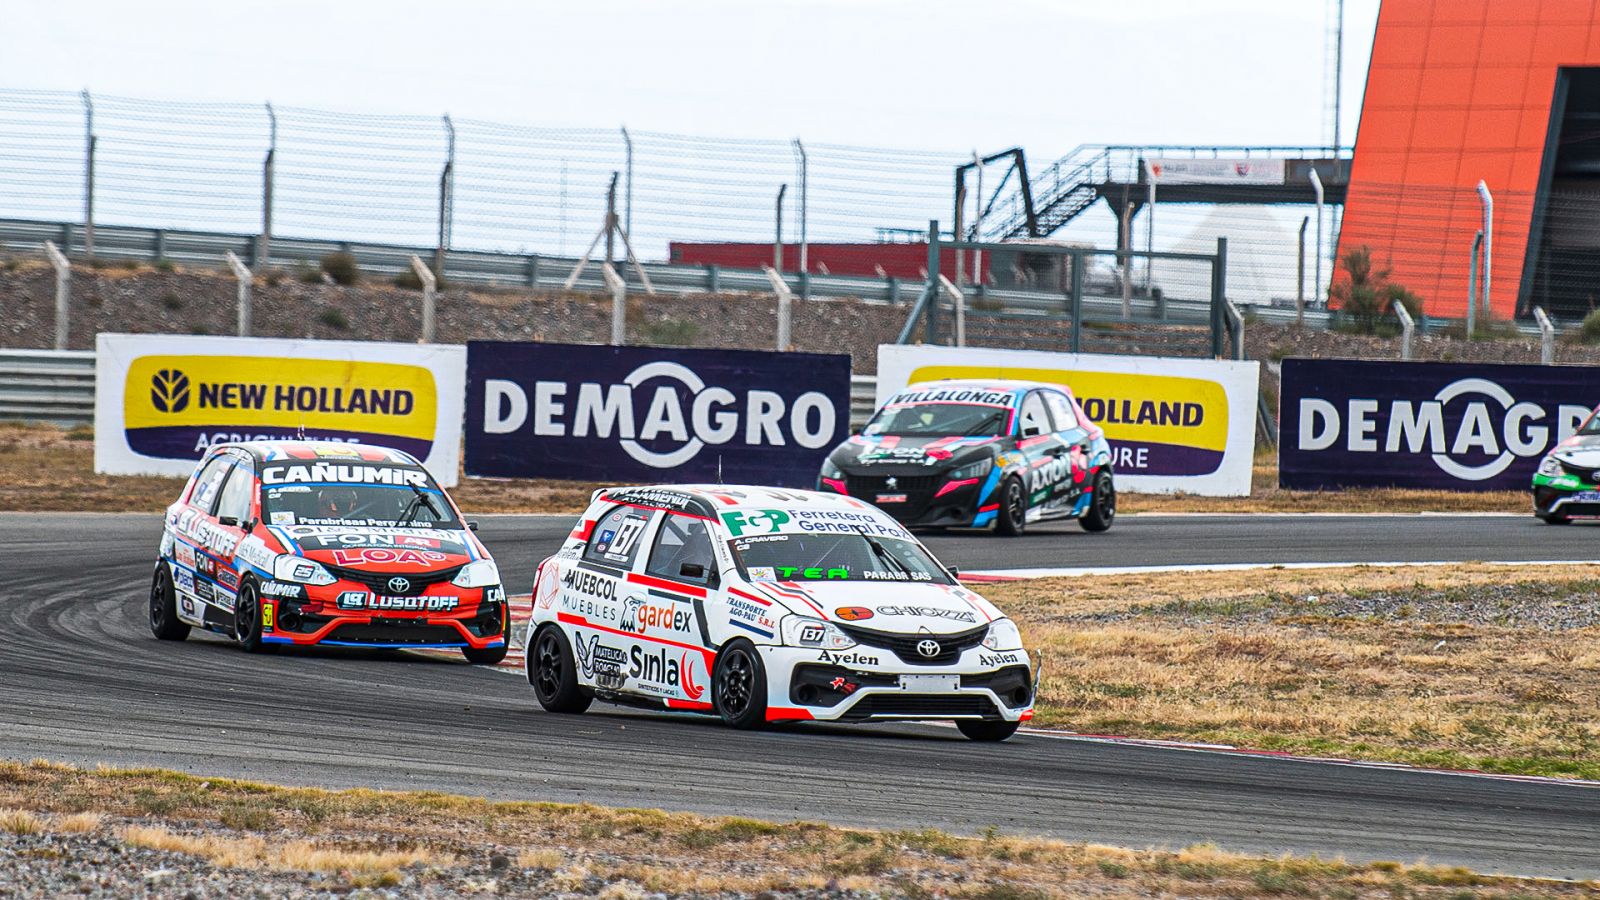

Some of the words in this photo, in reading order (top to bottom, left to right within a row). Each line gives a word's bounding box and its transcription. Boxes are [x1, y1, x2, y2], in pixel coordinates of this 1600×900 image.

[199, 383, 267, 410] NEW
[275, 386, 414, 416] HOLLAND
[894, 390, 1013, 407] VILLALONGA
[484, 378, 836, 449] DEMAGRO
[1078, 398, 1204, 427] OLLAND
[299, 516, 368, 528] Parabrisas
[721, 509, 791, 537] FGP
[788, 510, 877, 524] Ferretera
[799, 520, 875, 535] General
[317, 534, 395, 546] FON
[744, 535, 789, 544] CRAVERO
[777, 566, 849, 579] TEA
[863, 570, 933, 581] PARABRSAS
[564, 569, 617, 602] MUEBCOL
[562, 594, 616, 621] MUEBLES
[726, 597, 768, 617] TRANSPORTE
[729, 607, 757, 622] AGO-PAU
[638, 602, 692, 633] gardex
[818, 650, 879, 666] Ayelen
[979, 652, 1019, 667] Ayelen
